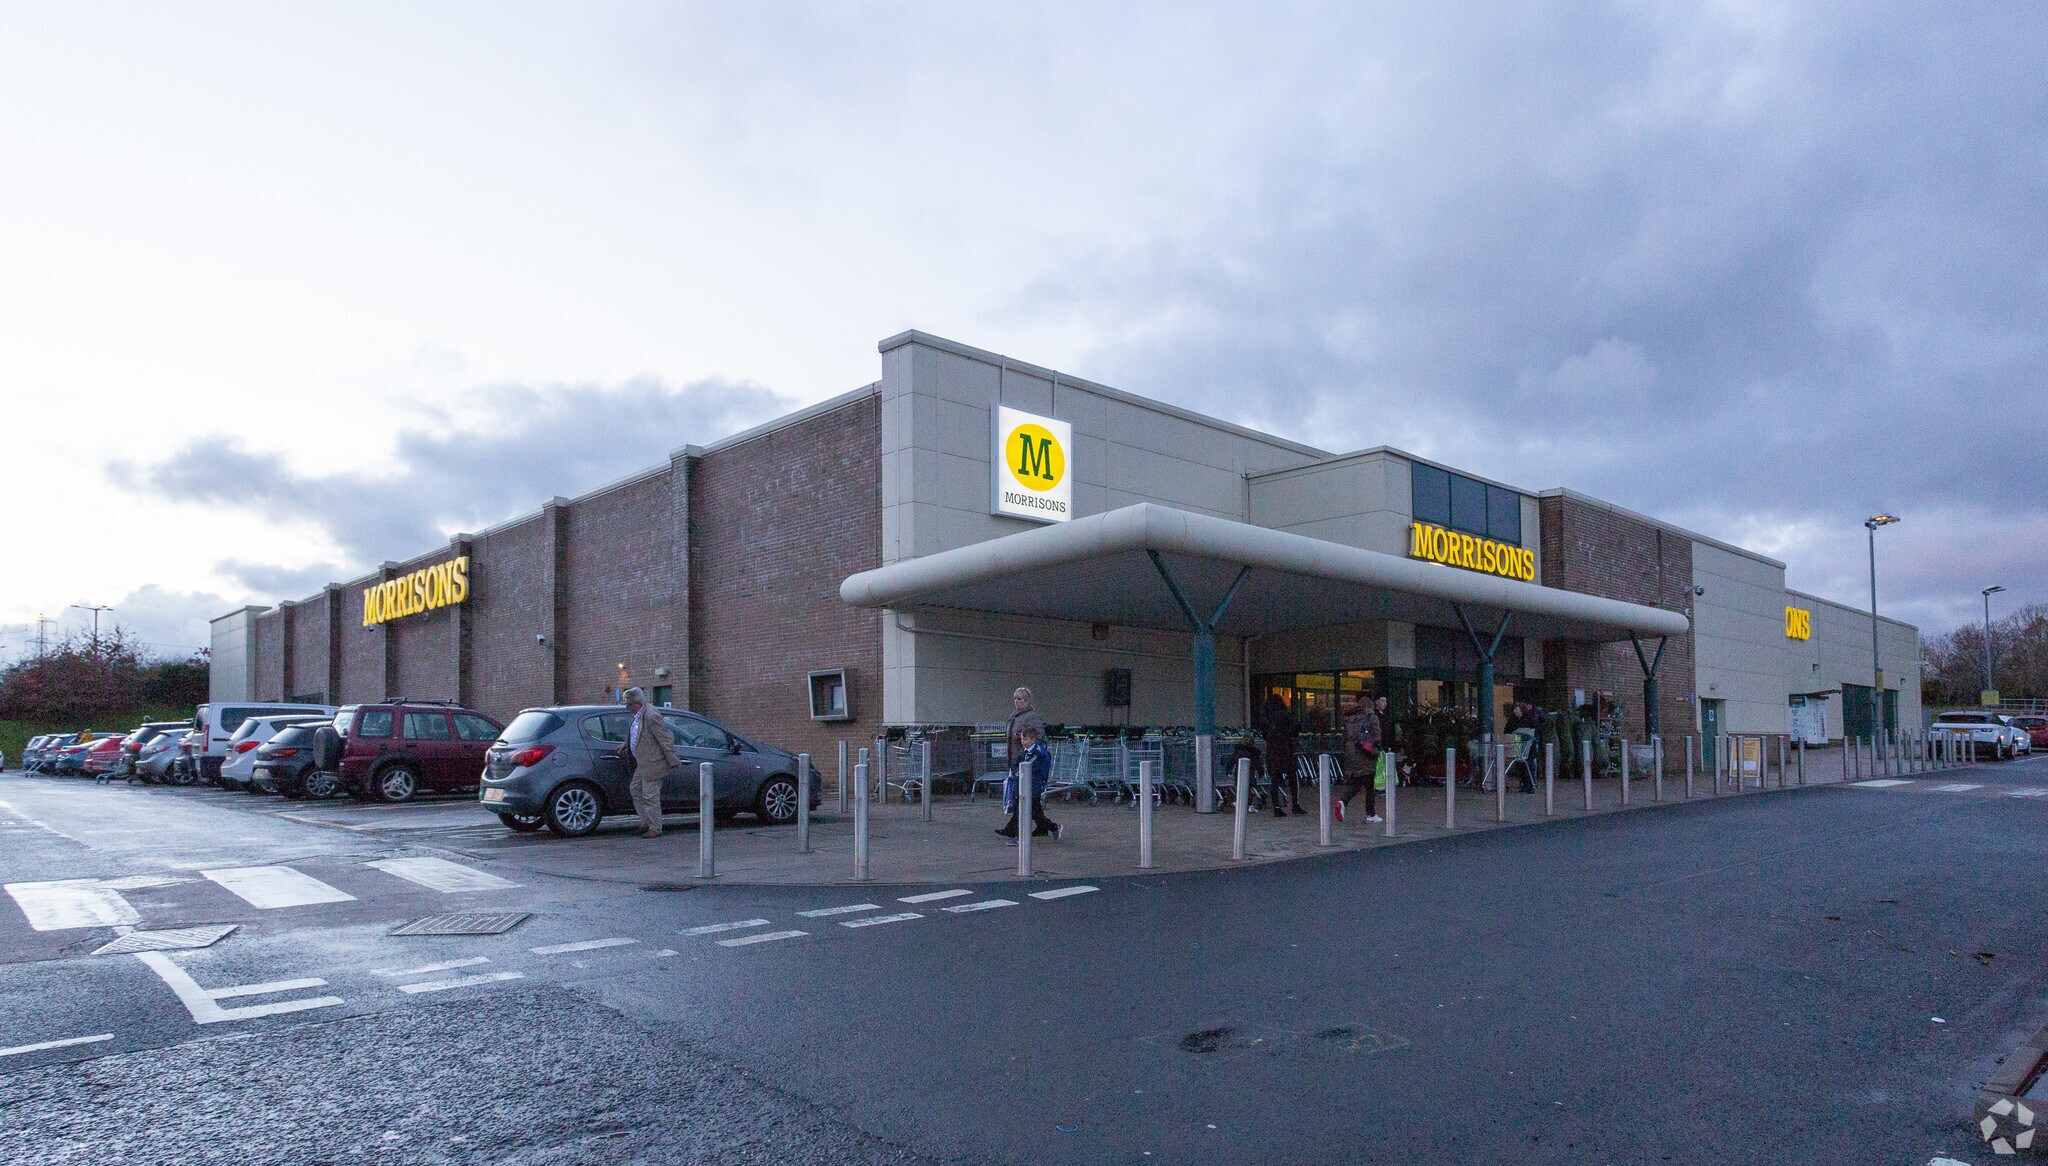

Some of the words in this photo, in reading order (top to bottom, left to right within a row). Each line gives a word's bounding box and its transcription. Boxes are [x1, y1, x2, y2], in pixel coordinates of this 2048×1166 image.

[1018, 433, 1054, 480] M
[1005, 492, 1066, 513] MORRISONS
[1413, 522, 1535, 581] MORRISONS
[363, 556, 468, 627] MORRISONS
[1785, 606, 1810, 640] ONS
